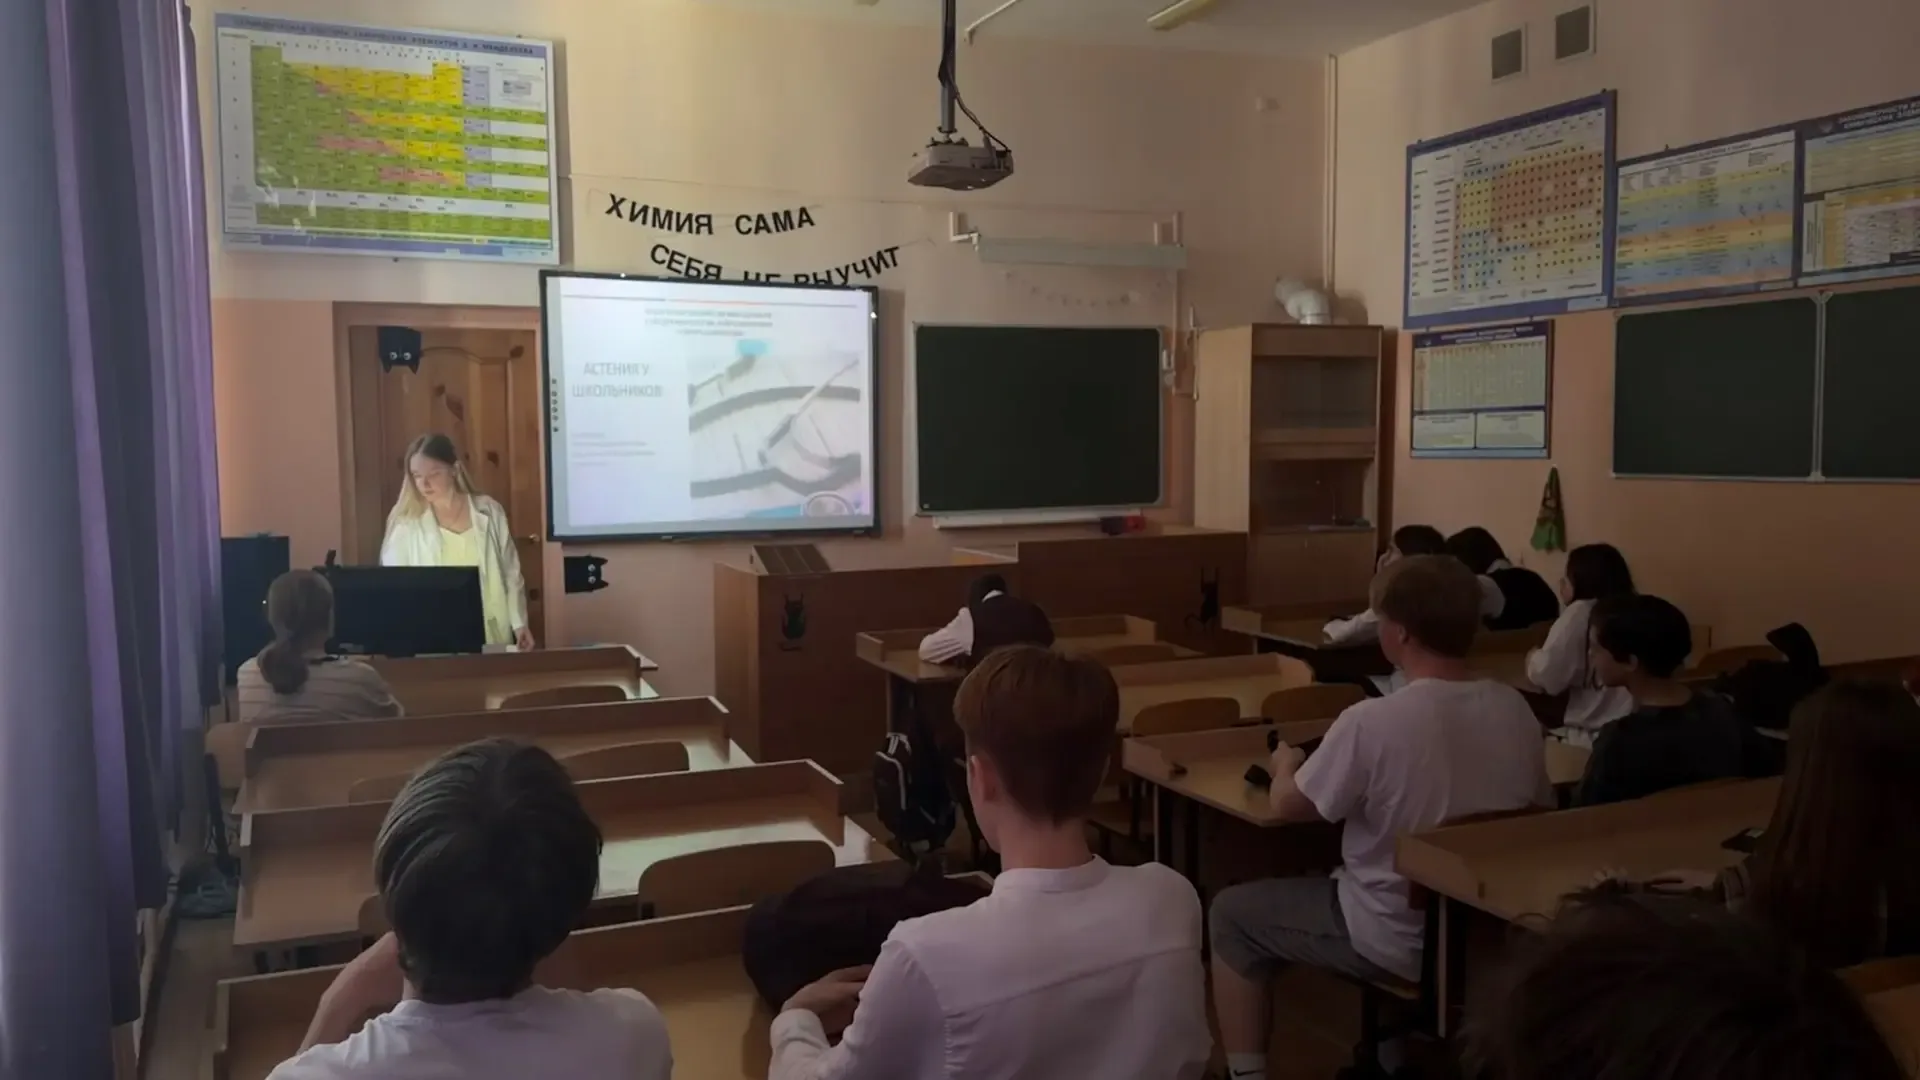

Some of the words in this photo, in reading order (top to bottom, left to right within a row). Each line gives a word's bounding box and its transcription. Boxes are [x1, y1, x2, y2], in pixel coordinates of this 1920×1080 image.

[605, 193, 713, 235] ХИМИЯ
[735, 206, 815, 235] САМА
[650, 244, 723, 281] СЕБЯ
[571, 384, 664, 398] ШКОЛЬНИКОВ
